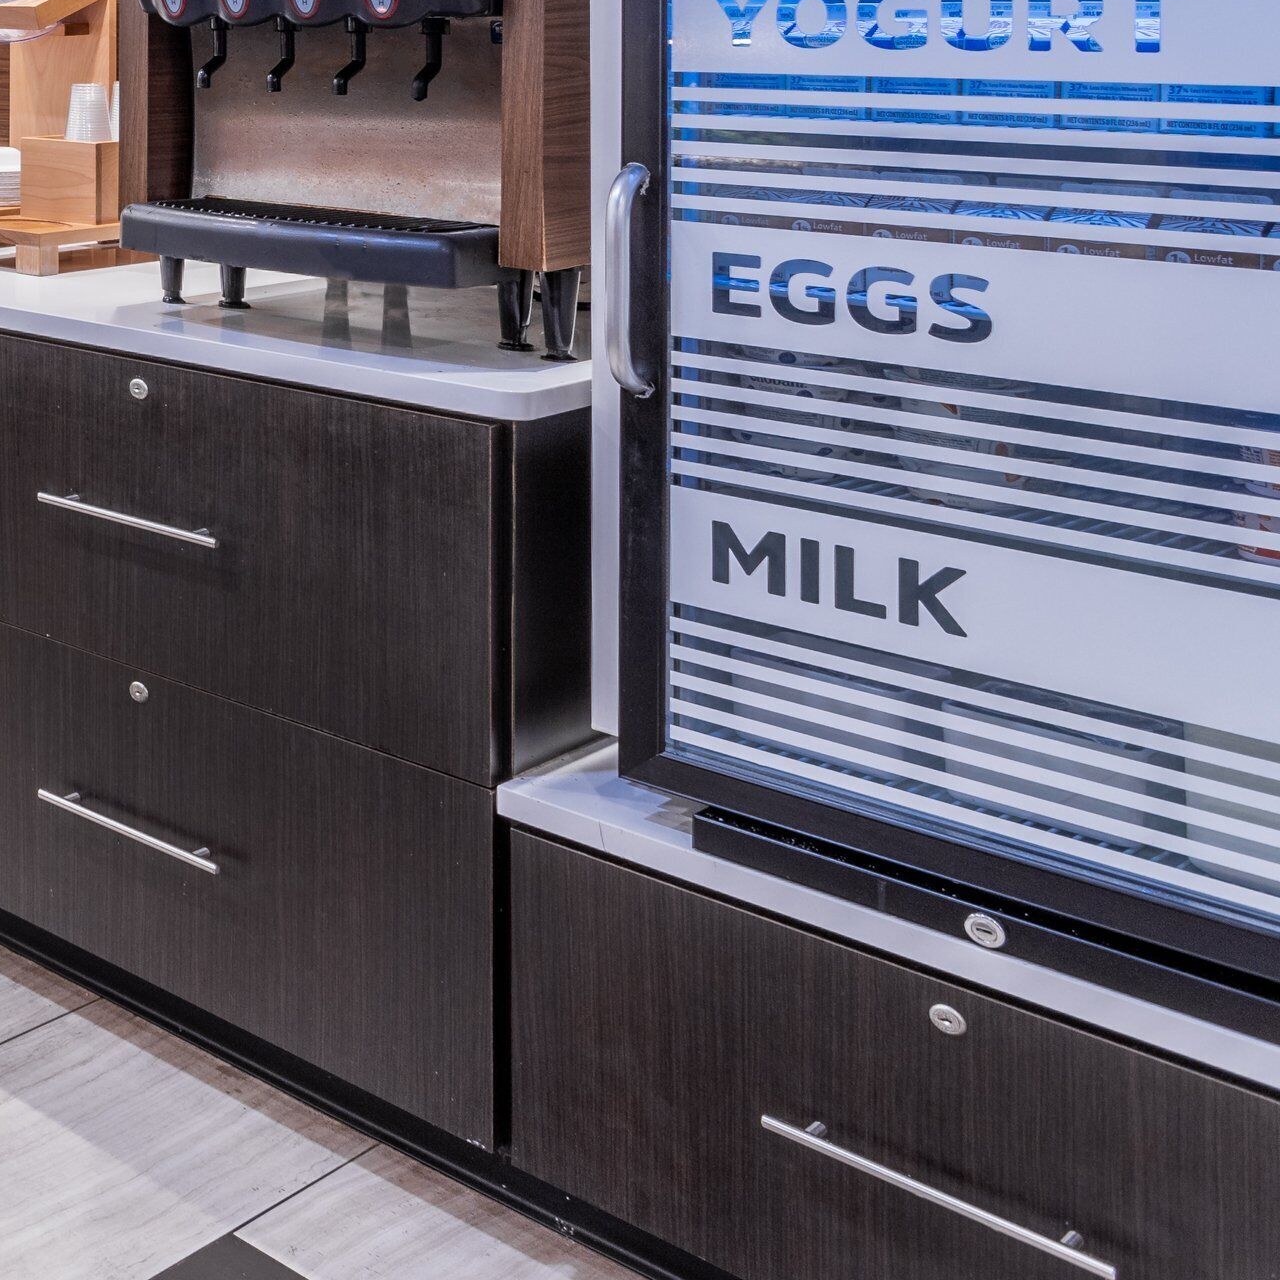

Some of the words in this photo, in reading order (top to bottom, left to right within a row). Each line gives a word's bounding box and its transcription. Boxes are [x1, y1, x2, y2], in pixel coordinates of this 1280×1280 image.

[813, 221, 843, 232] Lowfat
[895, 230, 928, 241] Lowfat
[986, 238, 1021, 250] Lowfat
[1083, 246, 1121, 258] Lowfat
[1194, 253, 1234, 265] Lowfat
[712, 251, 993, 344] EGGS
[712, 519, 968, 638] MILK
